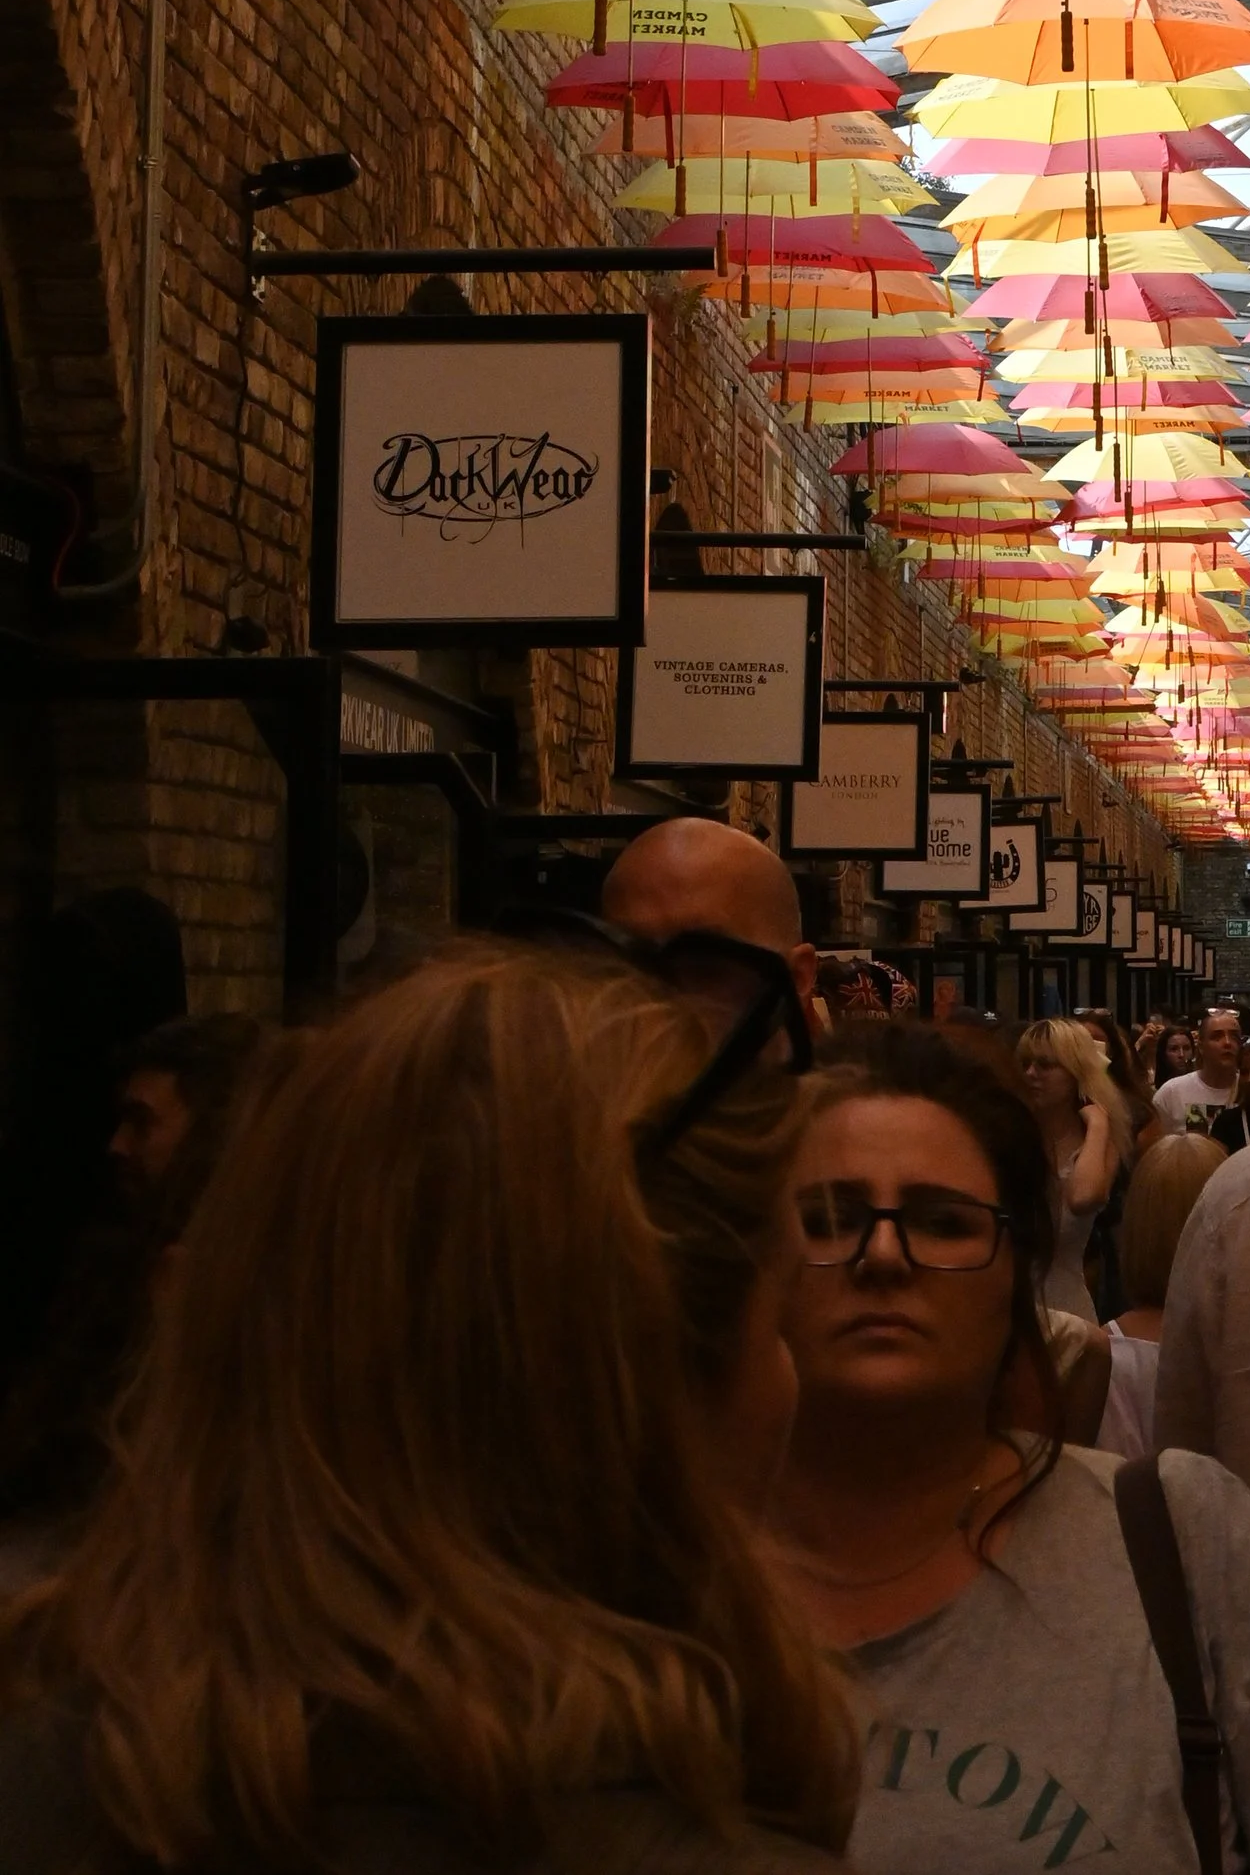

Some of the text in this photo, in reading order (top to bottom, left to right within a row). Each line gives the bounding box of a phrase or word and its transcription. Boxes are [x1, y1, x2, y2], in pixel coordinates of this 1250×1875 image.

[904, 405, 949, 413] MARKET
[477, 501, 516, 511] UK
[653, 660, 788, 674] VINTAGE CAMERAS,
[673, 672, 768, 685] SOUVENIRS &
[684, 684, 756, 697] CLOTHING
[808, 774, 902, 790] CAMBERRY
